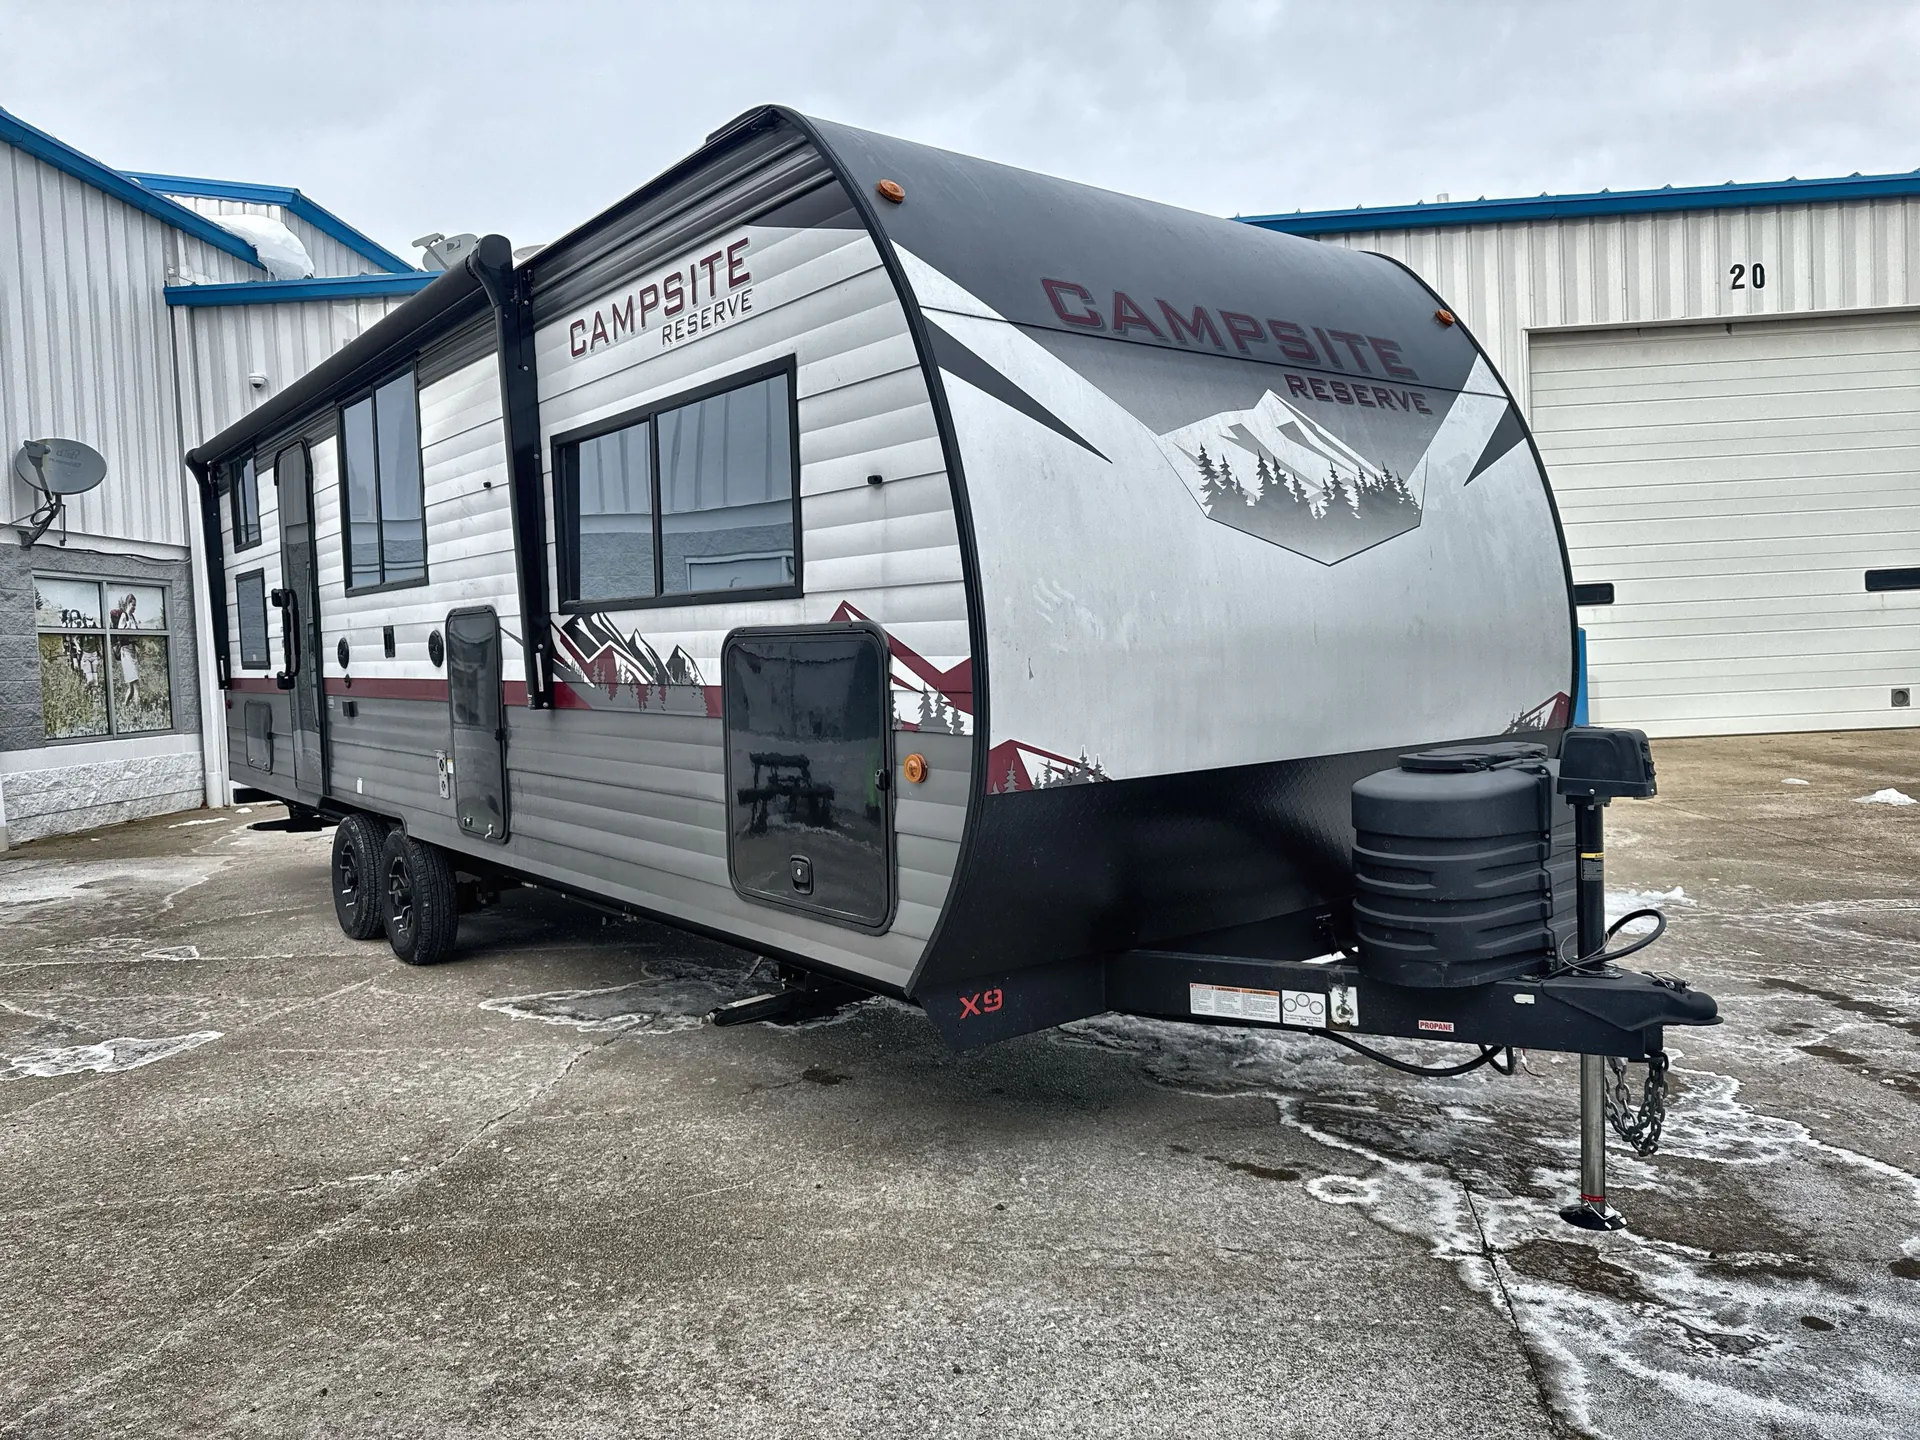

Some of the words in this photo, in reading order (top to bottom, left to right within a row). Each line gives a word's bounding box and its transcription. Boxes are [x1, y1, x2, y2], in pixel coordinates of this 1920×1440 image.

[1730, 263, 1765, 289] 20
[569, 237, 751, 358] CAMPSITE
[662, 289, 753, 346] RESERVE
[1041, 277, 1419, 380] CAMPSITE
[1284, 373, 1433, 414] RESERVE
[960, 988, 1002, 1019] X9
[1420, 1021, 1453, 1031] PROPANE
